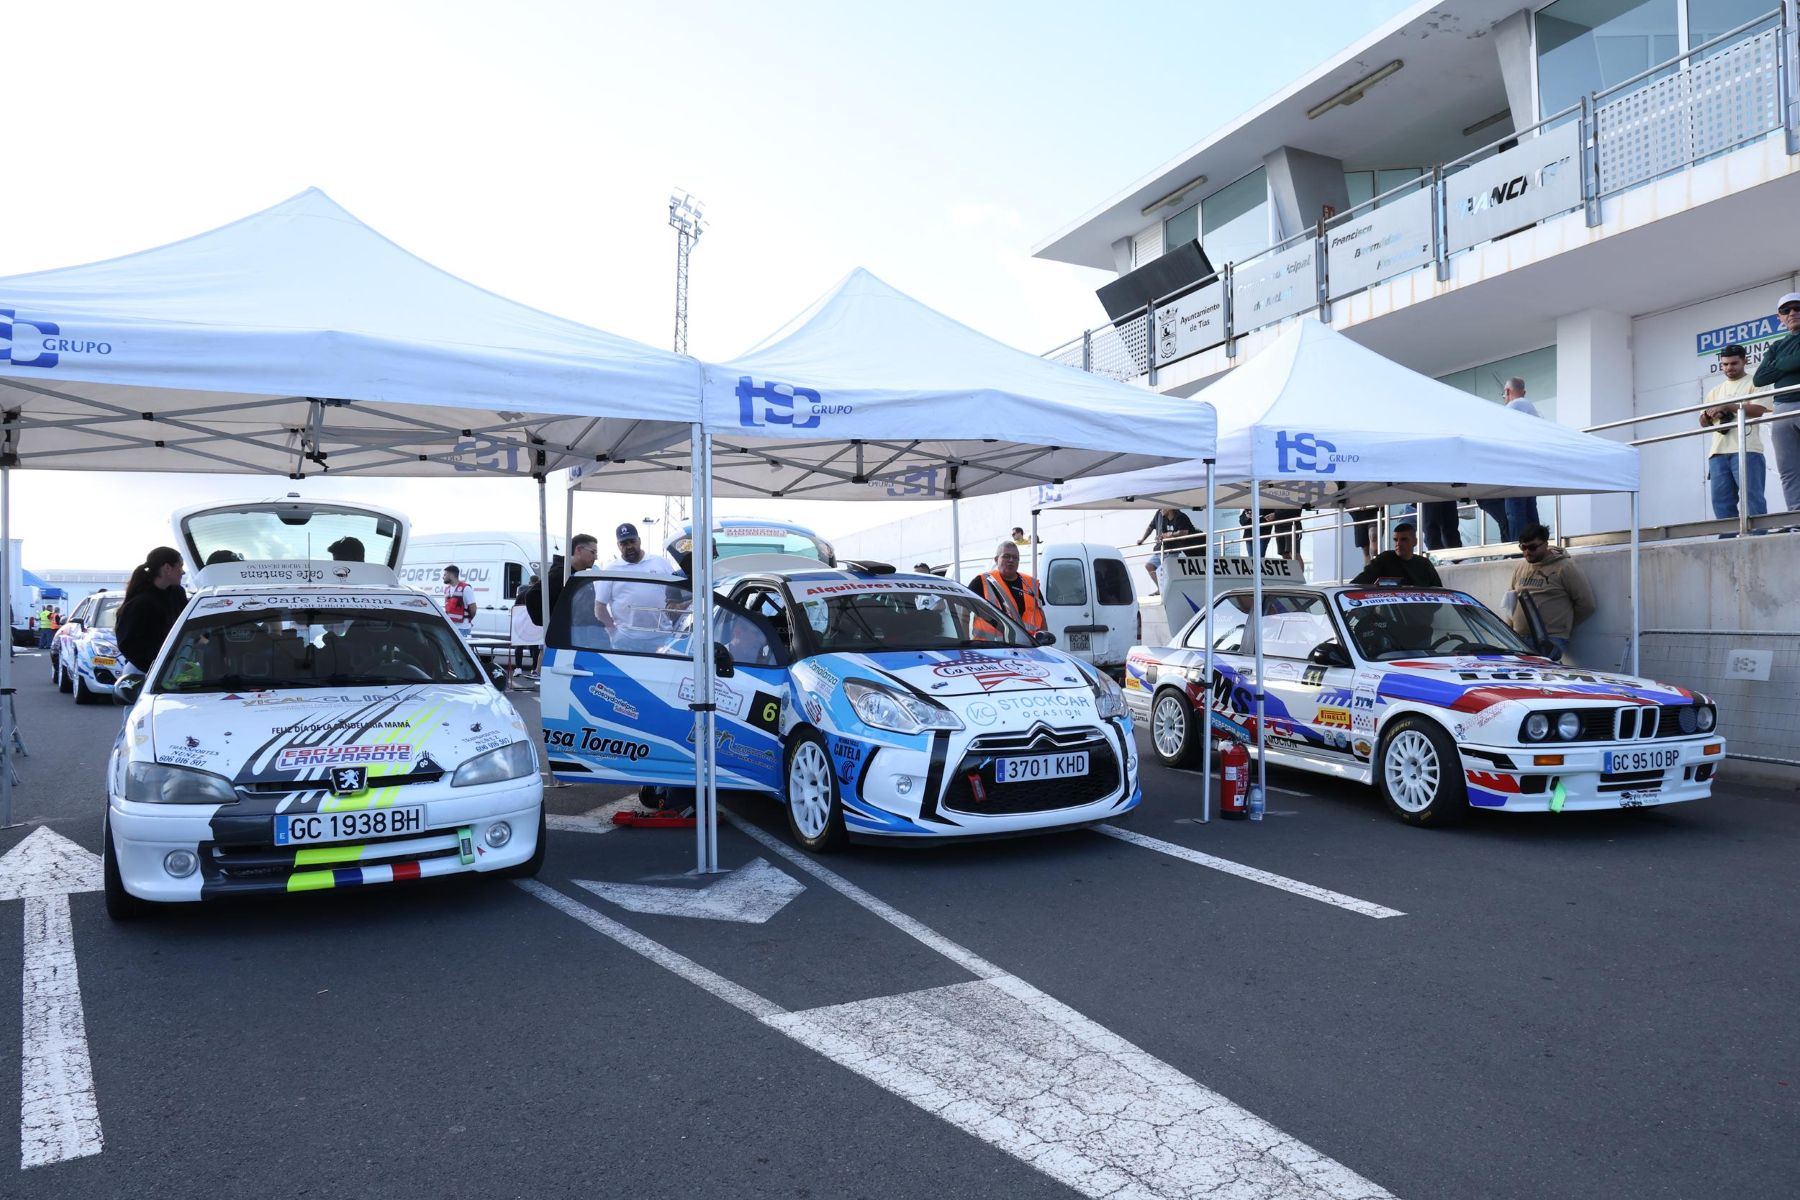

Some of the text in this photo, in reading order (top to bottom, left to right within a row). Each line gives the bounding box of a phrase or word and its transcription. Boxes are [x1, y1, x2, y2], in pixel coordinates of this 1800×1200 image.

[1180, 302, 1220, 325] Ayuntamiento
[1189, 323, 1199, 333] de
[1700, 319, 1773, 350] PUERTA
[42, 338, 112, 355] GRUPO
[811, 404, 853, 415] GRUPO
[1328, 454, 1360, 464] GRUPO
[240, 570, 324, 580] Cafe Santana
[398, 568, 440, 582] PORTS
[806, 583, 892, 596] Alquileres
[267, 596, 394, 606] Cafe Santana
[943, 663, 999, 676] Ca Puchi
[997, 694, 1091, 711] STOCKCAR
[763, 702, 778, 722] 6
[1022, 708, 1082, 719] OCASION
[271, 726, 293, 735] FELIZ
[542, 728, 650, 762] asa Torano
[158, 754, 174, 764] 606
[174, 756, 189, 765] 016
[280, 751, 410, 767] LANZAROTE
[1613, 749, 1680, 771] GC 9510 BP
[1008, 755, 1085, 779] 3701 KHD
[290, 808, 420, 840] GC 1938 BH
